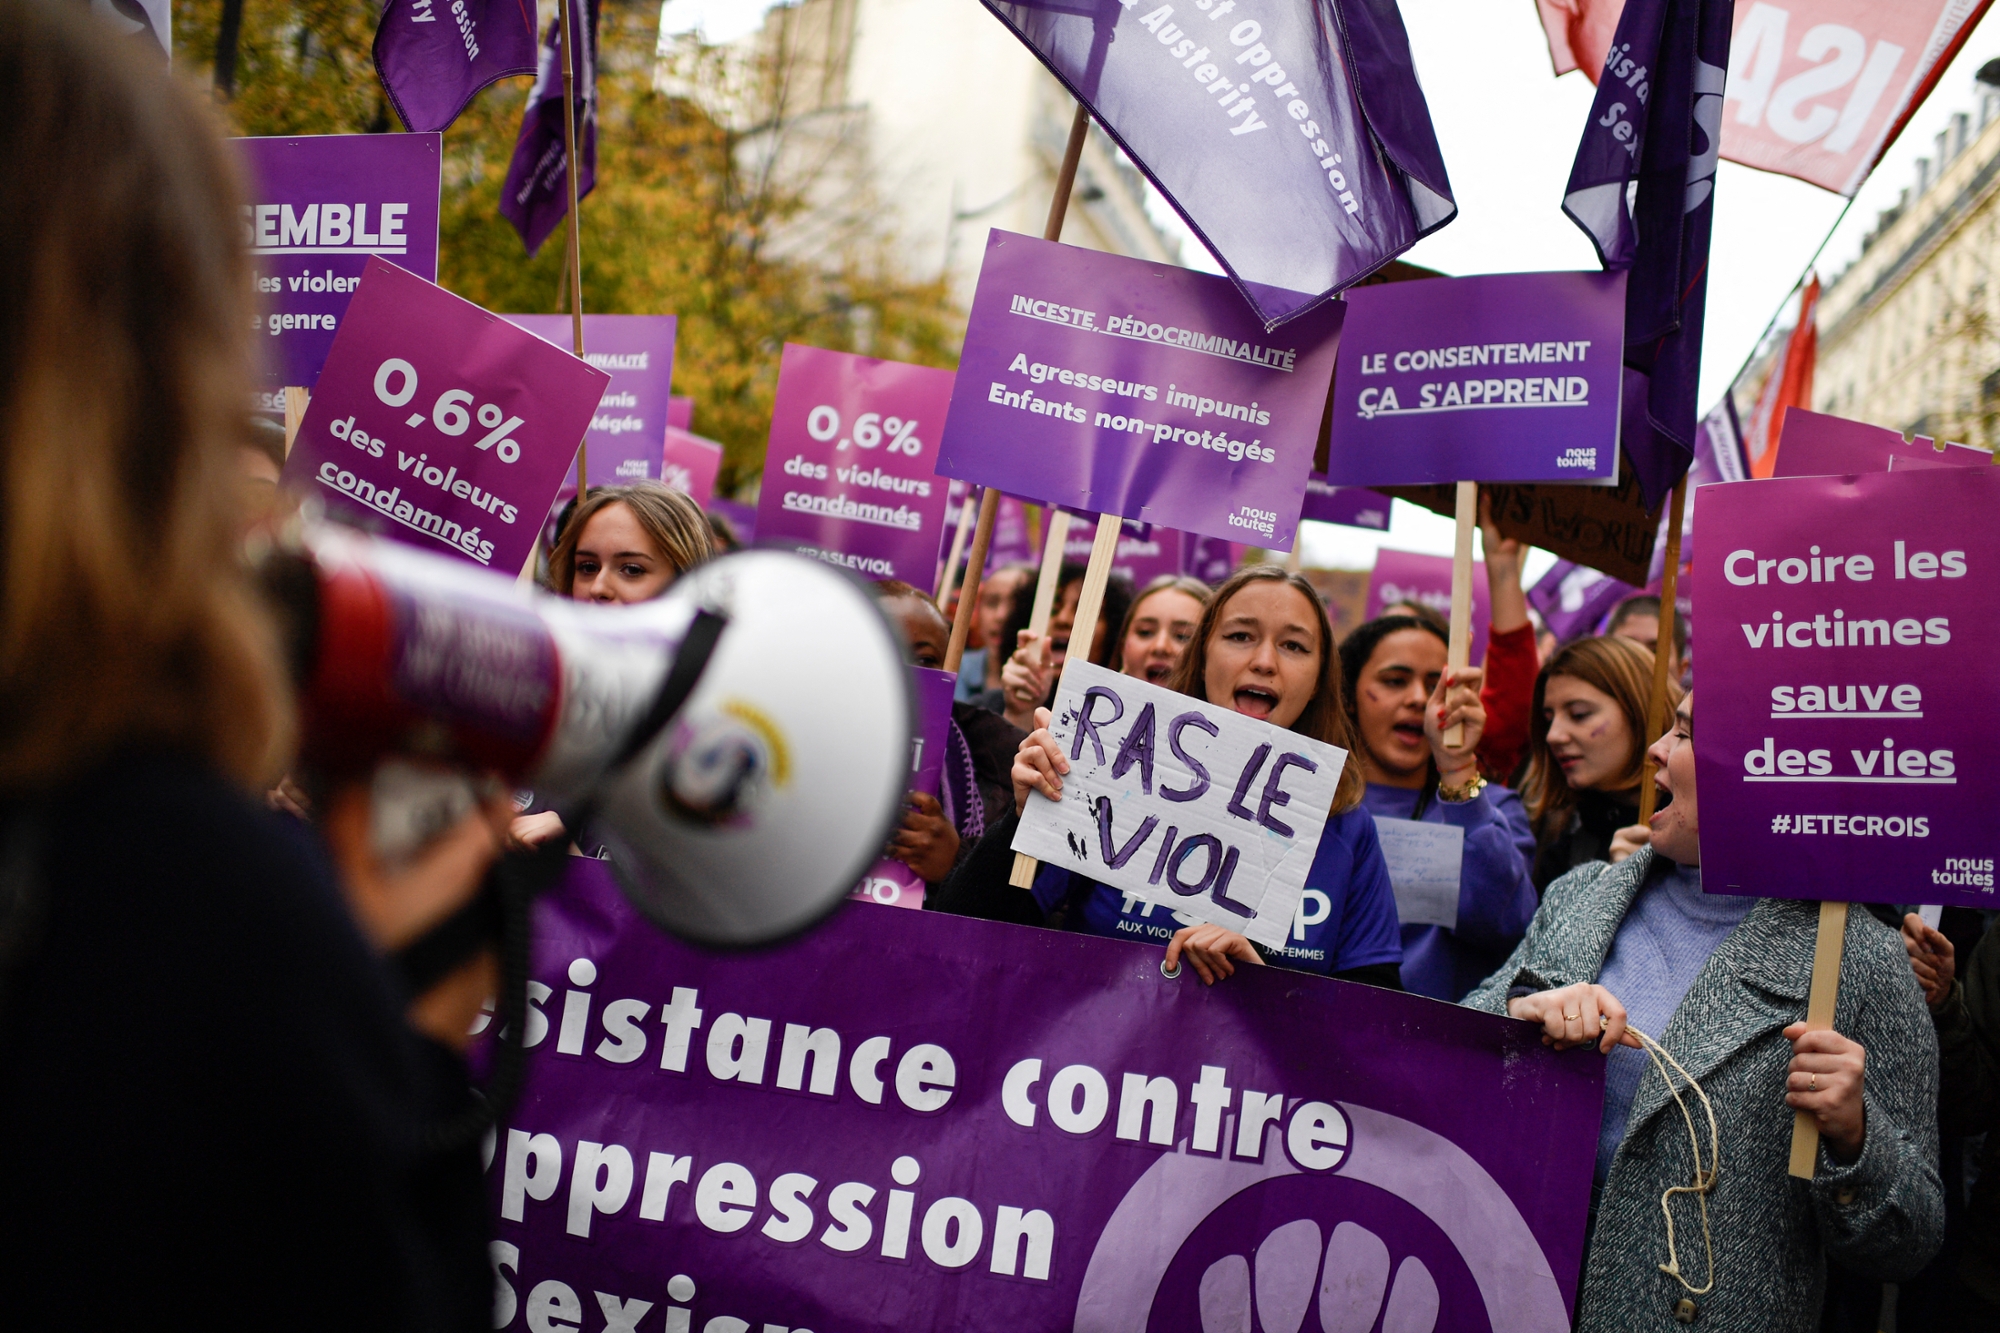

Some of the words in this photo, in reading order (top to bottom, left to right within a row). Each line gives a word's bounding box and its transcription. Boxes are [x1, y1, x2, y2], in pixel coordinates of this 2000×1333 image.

[446, 0, 479, 61] ession
[1138, 4, 1268, 136] Austerity
[1229, 19, 1358, 214] Oppression
[268, 313, 336, 336] genre
[1010, 294, 1099, 332] INCESTE,
[1106, 314, 1297, 370] PÉDOCRIMINALITÉ
[1361, 354, 1387, 375] LE
[1393, 340, 1591, 373] CONSENTEMENT
[373, 358, 525, 463] 0,6%
[1008, 352, 1158, 401] Agresseurs
[1166, 384, 1271, 426] impunis
[1358, 387, 1399, 419] ÇA
[1419, 376, 1589, 409] S'APPREND
[589, 413, 644, 435] tégés
[806, 404, 922, 456] 0,6%
[987, 382, 1087, 424] Enfants
[1094, 412, 1276, 463] non-protégés
[329, 416, 386, 458] des
[397, 450, 518, 525] violeurs
[1556, 456, 1596, 467] toutes
[1565, 447, 1597, 458] nous
[784, 454, 828, 480] des
[835, 464, 931, 498] violeurs
[318, 461, 495, 563] condamnés
[782, 491, 921, 529] condamnés
[1228, 512, 1275, 533] toutes
[1240, 505, 1277, 522] nous
[1723, 545, 1874, 586] Croire
[1894, 540, 1967, 580] les
[1741, 609, 1951, 648] victimes
[1771, 683, 1923, 713] sauve
[1069, 685, 1219, 803] RAS
[1227, 741, 1319, 839] LE
[1744, 738, 1832, 777] des
[1851, 738, 1956, 778] vies
[1771, 814, 1930, 838] #JETECROIS
[1095, 795, 1257, 919] VIOL
[1931, 868, 1994, 887] toutes
[1945, 857, 1994, 872] nous
[1116, 919, 1143, 935] AUX
[1279, 946, 1325, 961] FEMMES
[1001, 1057, 1348, 1171] contre
[481, 1125, 1055, 1281] ppression
